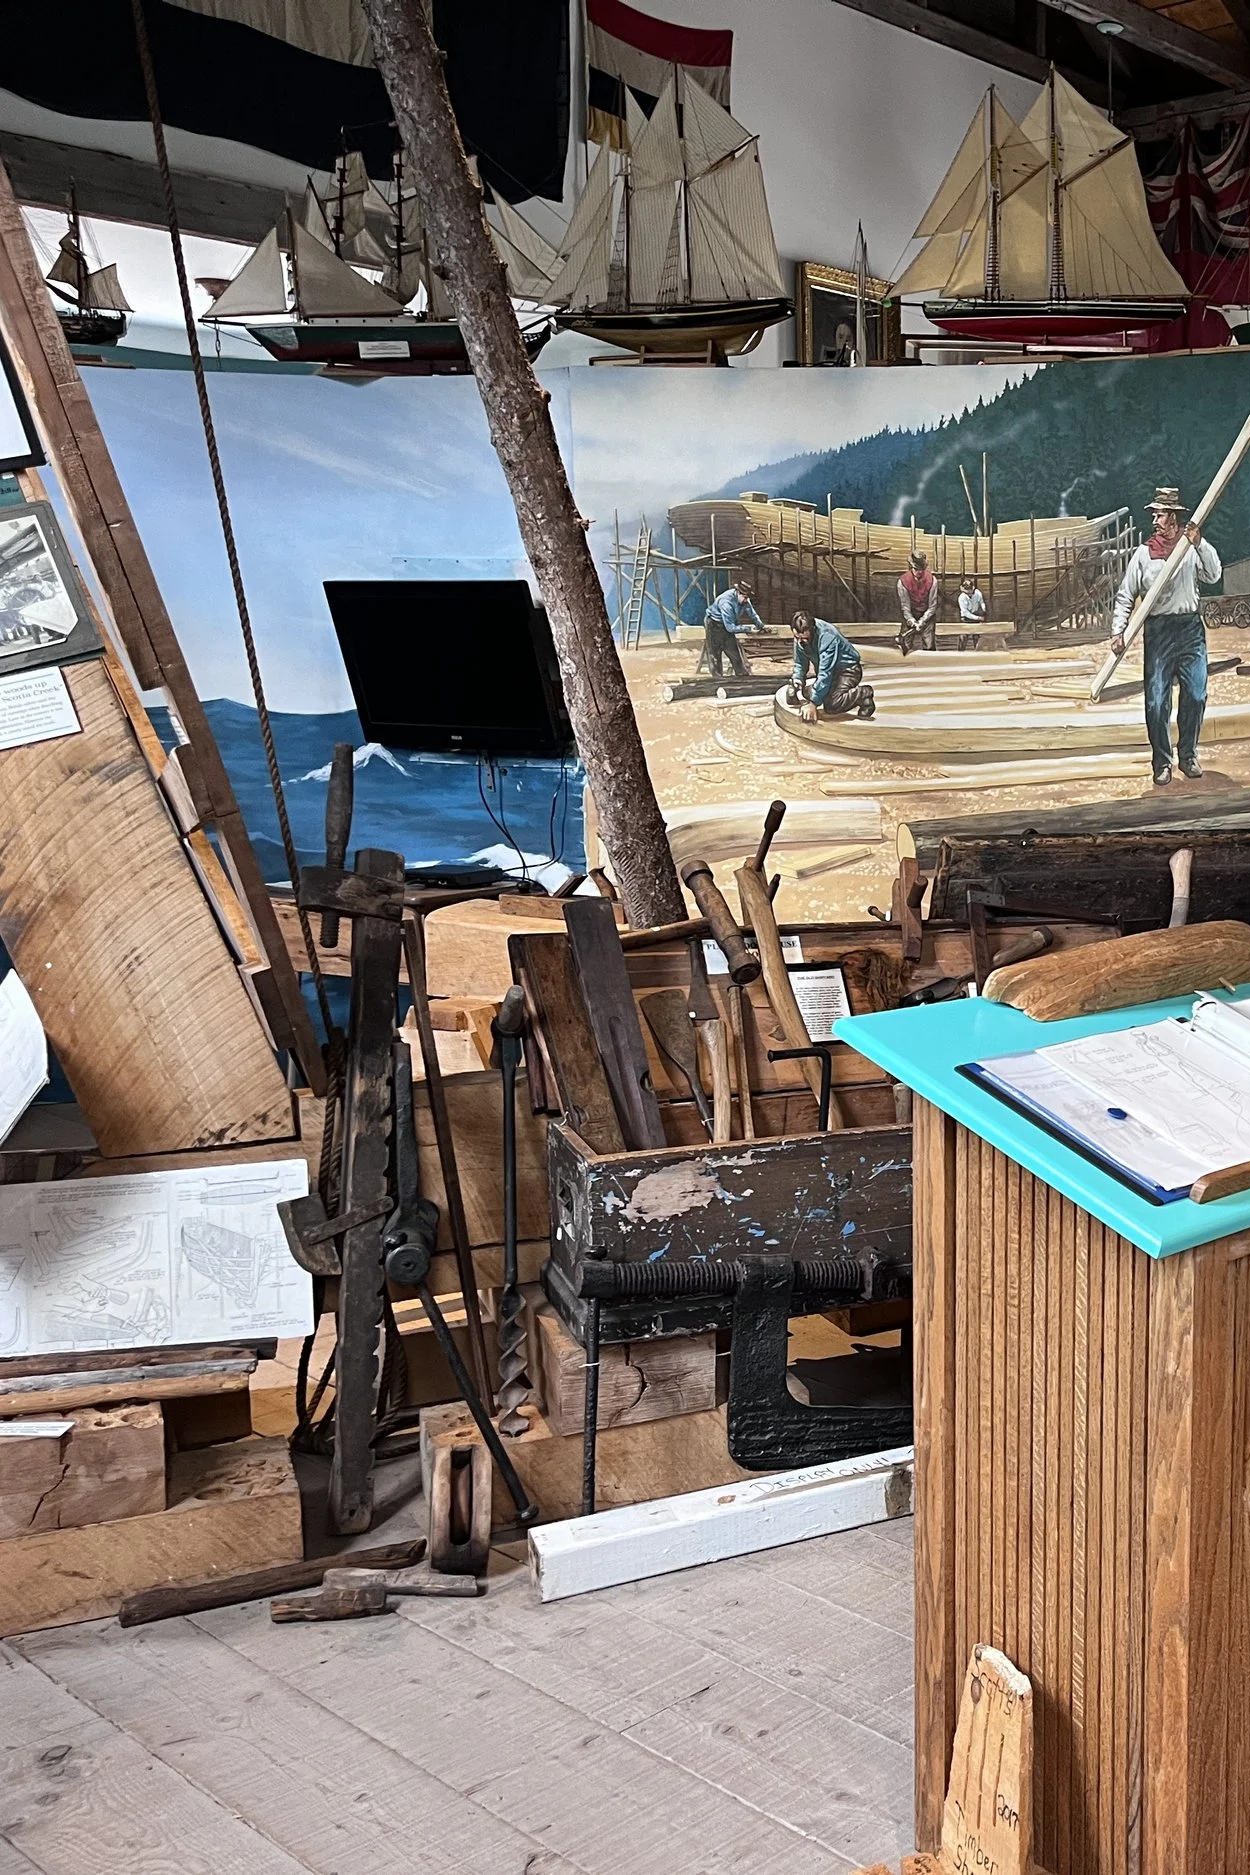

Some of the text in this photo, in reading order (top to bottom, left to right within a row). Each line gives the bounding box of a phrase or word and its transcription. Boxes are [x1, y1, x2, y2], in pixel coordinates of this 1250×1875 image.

[34, 681, 48, 689] up
[749, 1467, 835, 1493] DISPLAY
[997, 1794, 1019, 1832] 2017
